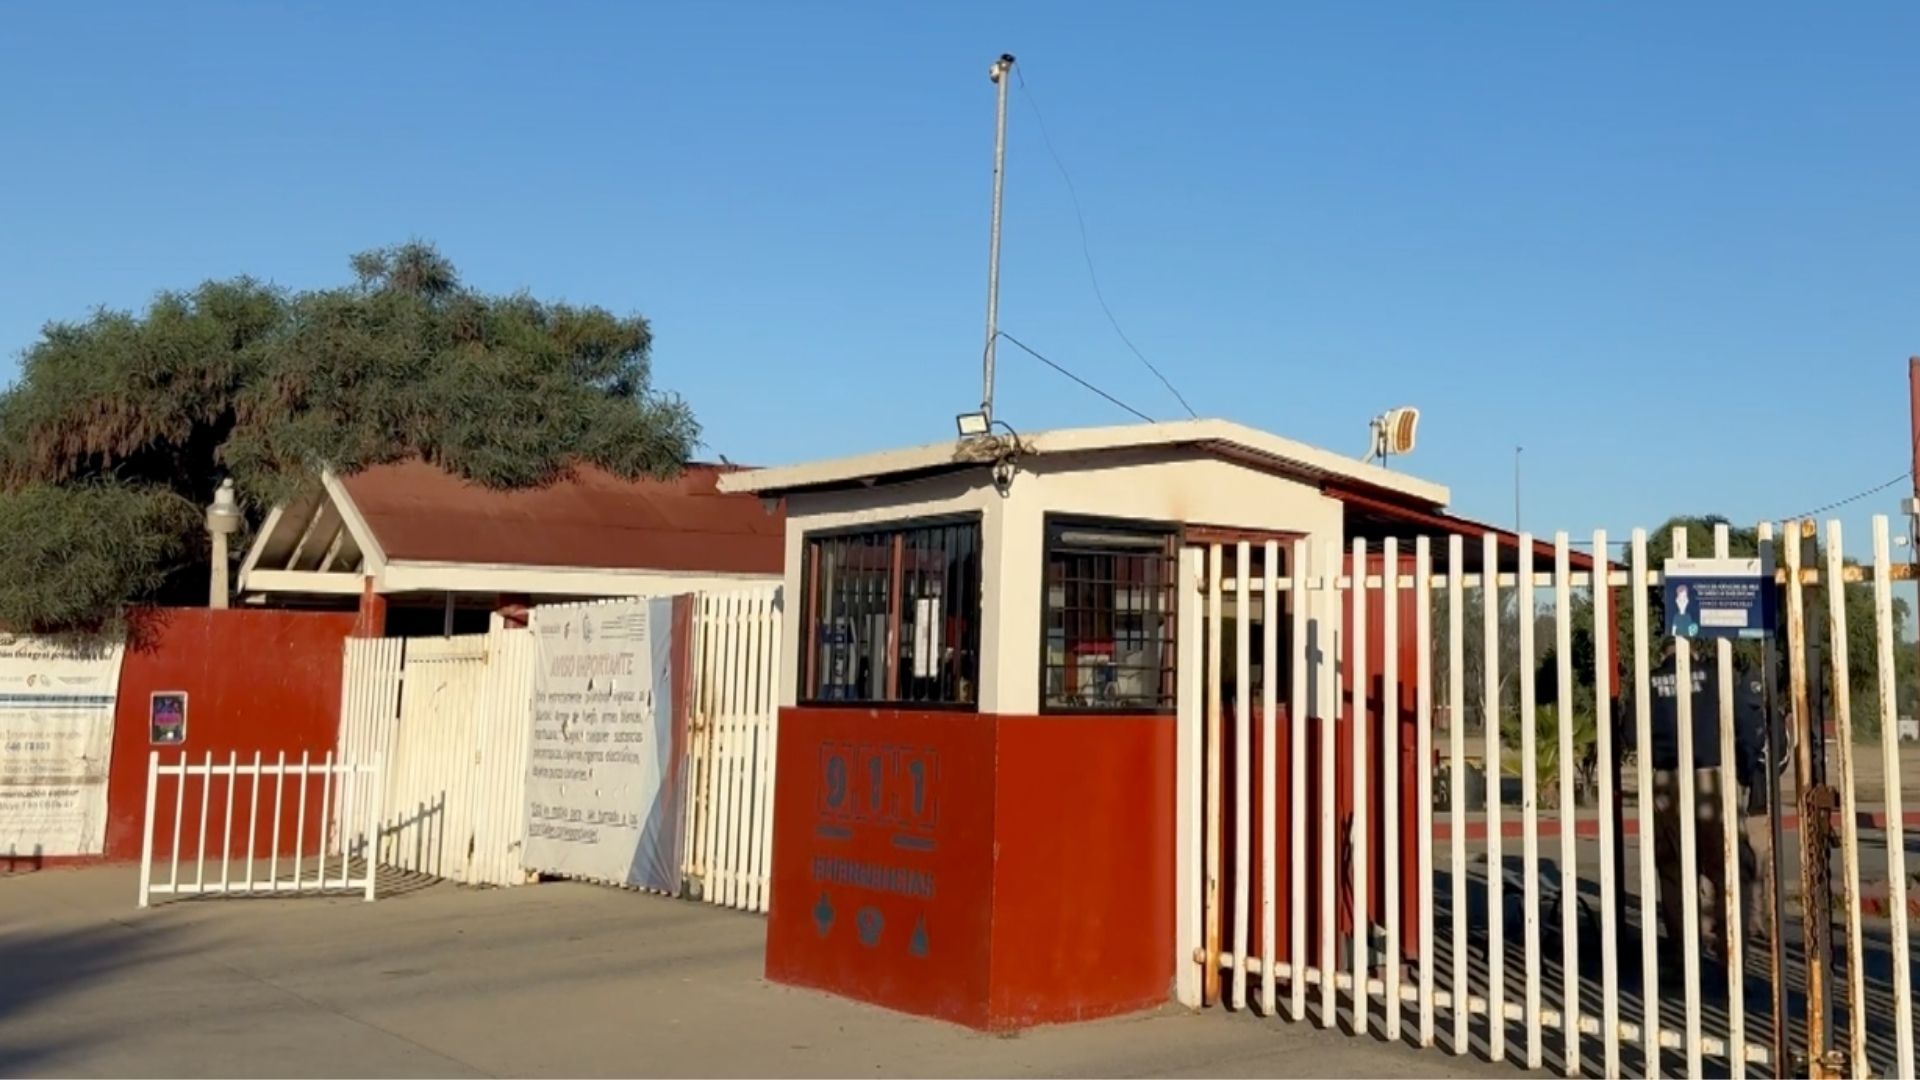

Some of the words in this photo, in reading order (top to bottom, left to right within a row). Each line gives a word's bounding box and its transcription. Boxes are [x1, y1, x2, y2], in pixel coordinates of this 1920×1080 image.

[550, 655, 576, 678] AVISO
[577, 652, 634, 678] IMPORTANTE
[825, 754, 926, 817] 911
